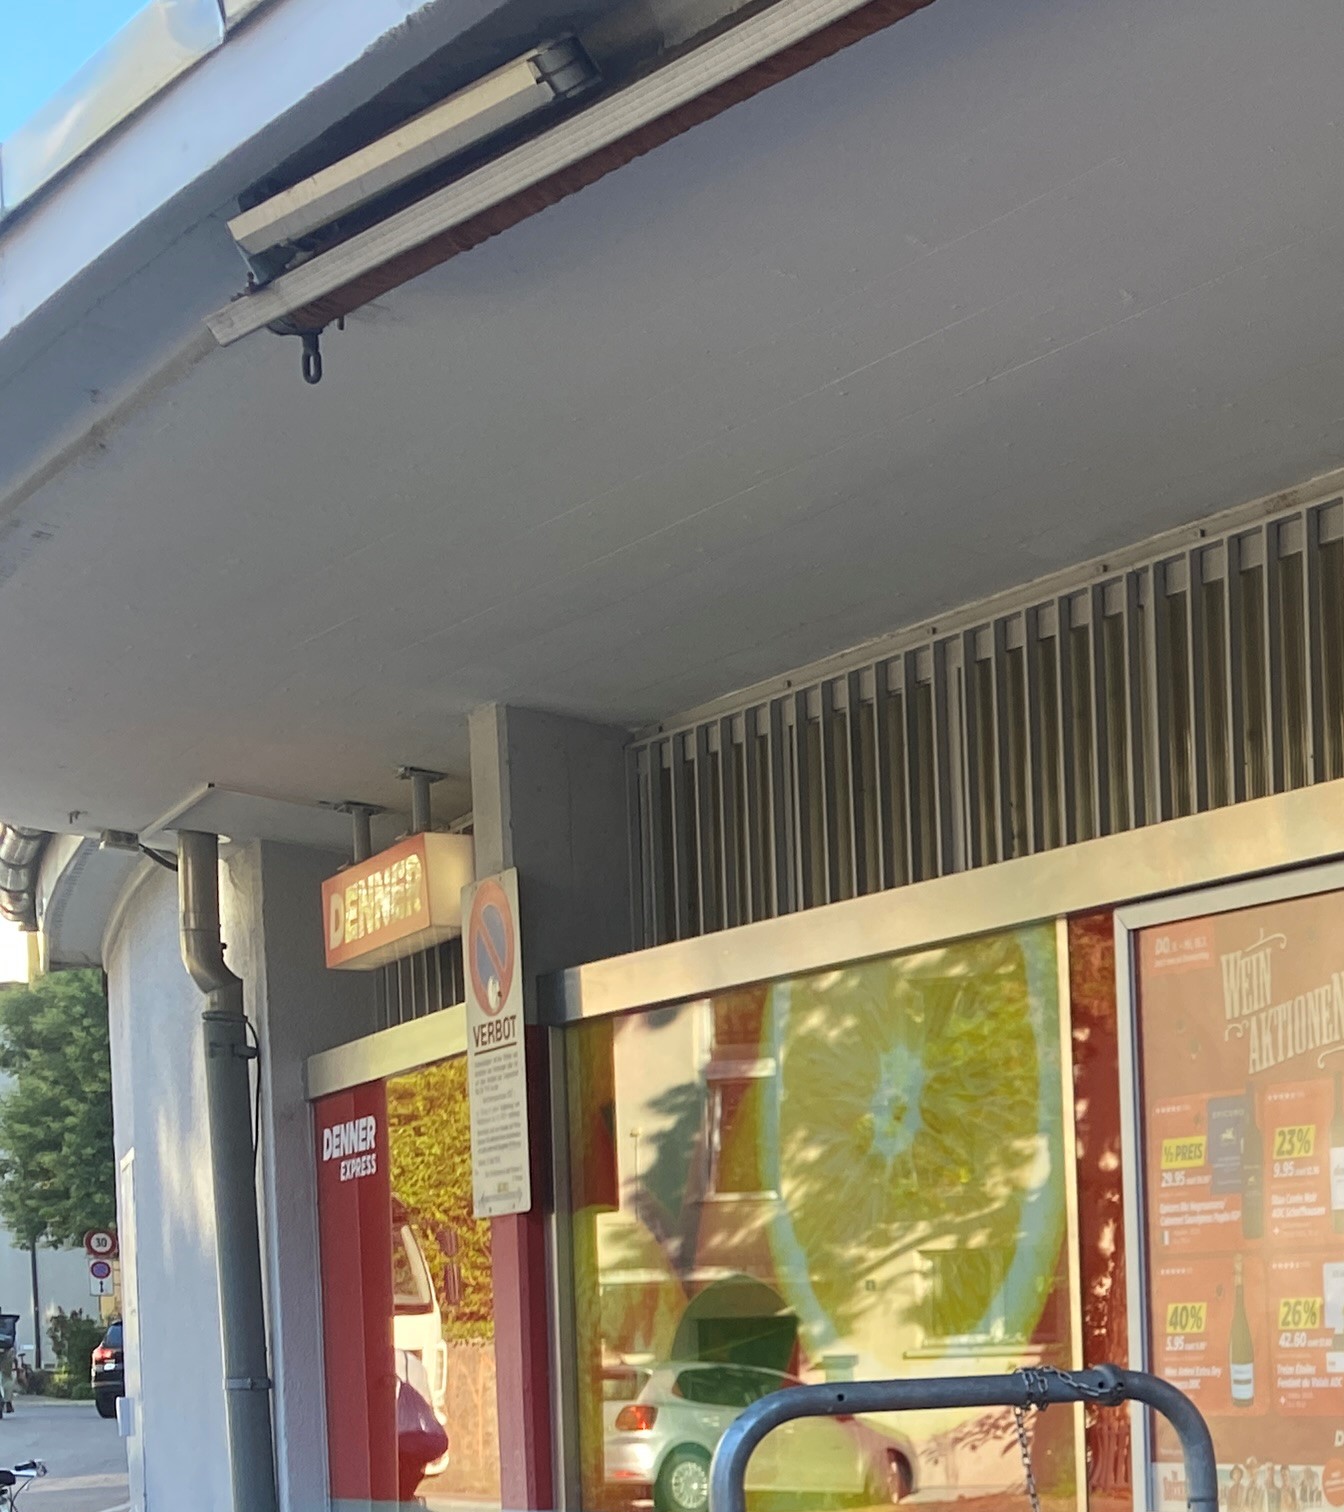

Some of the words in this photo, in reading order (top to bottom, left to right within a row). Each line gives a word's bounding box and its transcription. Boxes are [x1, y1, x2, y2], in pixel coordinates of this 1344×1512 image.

[330, 854, 421, 951] DENNER
[1220, 948, 1272, 1020] WEIN
[473, 1015, 516, 1047] VERBOT
[323, 1115, 376, 1161] DENNER
[1176, 1143, 1203, 1161] PREIS
[1276, 1127, 1311, 1156] 23%
[341, 1153, 376, 1181] EXPRESS
[94, 1237, 107, 1248] 30
[1169, 1305, 1202, 1331] 40%
[1281, 1300, 1317, 1326] 26%
